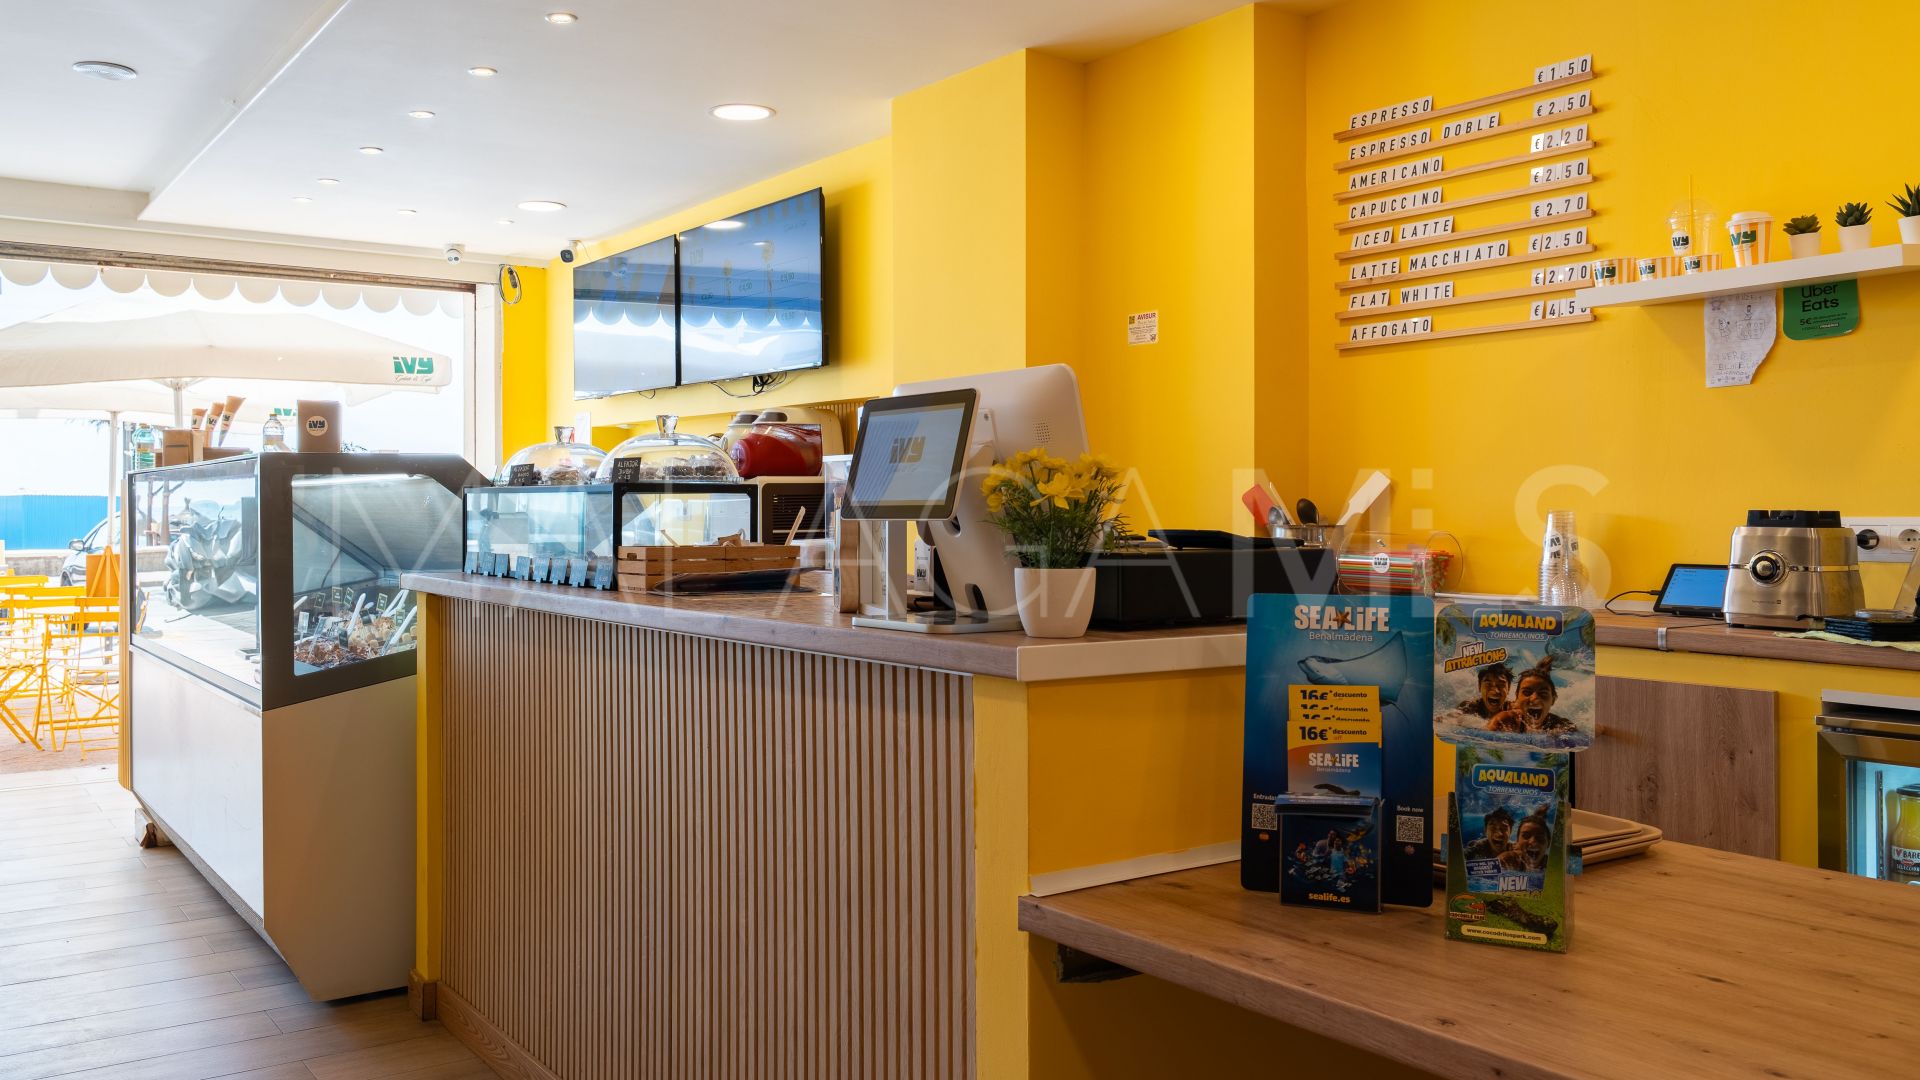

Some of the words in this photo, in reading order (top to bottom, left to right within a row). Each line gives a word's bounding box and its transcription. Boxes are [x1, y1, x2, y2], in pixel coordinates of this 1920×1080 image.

[1351, 99, 1430, 129] ESPRESSO
[1351, 131, 1428, 161] ESPRESSO
[1443, 115, 1497, 139] DOBLE
[1350, 159, 1440, 190] AMERICANO
[1351, 191, 1439, 219] CAPUCCINO
[1354, 230, 1390, 248] ICED
[1401, 219, 1451, 240] LATTE
[1351, 261, 1397, 280] LATTE
[1409, 243, 1505, 271] MACCHIATO
[1351, 292, 1388, 308] FLAT
[1401, 284, 1451, 304] WHITE
[1801, 284, 1839, 299] Uber
[1801, 298, 1840, 313] Eats
[1351, 318, 1430, 342] AFFOGATO
[1534, 300, 1588, 317] €4.5
[1294, 605, 1338, 630] SEA
[1479, 613, 1557, 630] AQUALAND
[1309, 631, 1373, 642] Benalmádena
[1489, 631, 1545, 640] TORREMOLINOS
[1462, 642, 1484, 657] NEW
[1444, 648, 1507, 673] ATTRACTIONS
[1308, 752, 1333, 767] SEA
[1478, 769, 1549, 787] AQUALAND
[1488, 786, 1539, 796] TORREMOLINOS
[1498, 875, 1529, 892] NEW
[1308, 892, 1351, 903] sealife.es
